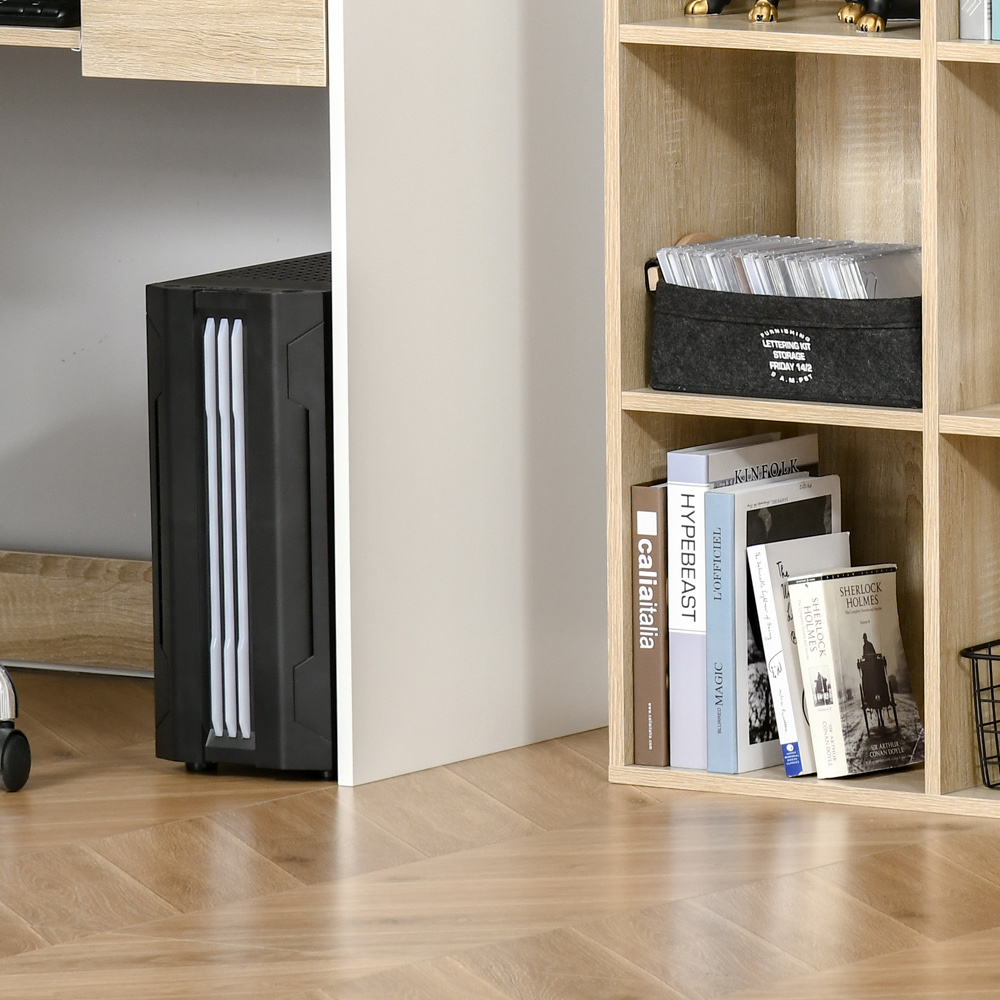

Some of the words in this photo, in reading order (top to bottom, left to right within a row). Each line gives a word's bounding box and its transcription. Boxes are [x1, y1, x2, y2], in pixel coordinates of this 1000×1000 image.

[762, 339, 800, 350] LETTERING
[800, 341, 811, 351] KIT
[772, 350, 806, 361] STORAGE
[769, 360, 795, 371] FRIDAY
[795, 362, 813, 373] 14/2
[734, 458, 799, 484] KINFOLK
[680, 493, 697, 623] HYPEBEAST
[712, 527, 722, 601] L'OFFICIEL
[776, 560, 790, 578] The
[638, 538, 658, 649] caliaitalia
[839, 582, 883, 597] SHERLOCK
[846, 594, 879, 608] HOLMES
[803, 605, 818, 653] HOLMES
[811, 597, 827, 658] SHERLOCK
[714, 662, 724, 706] MAGIC
